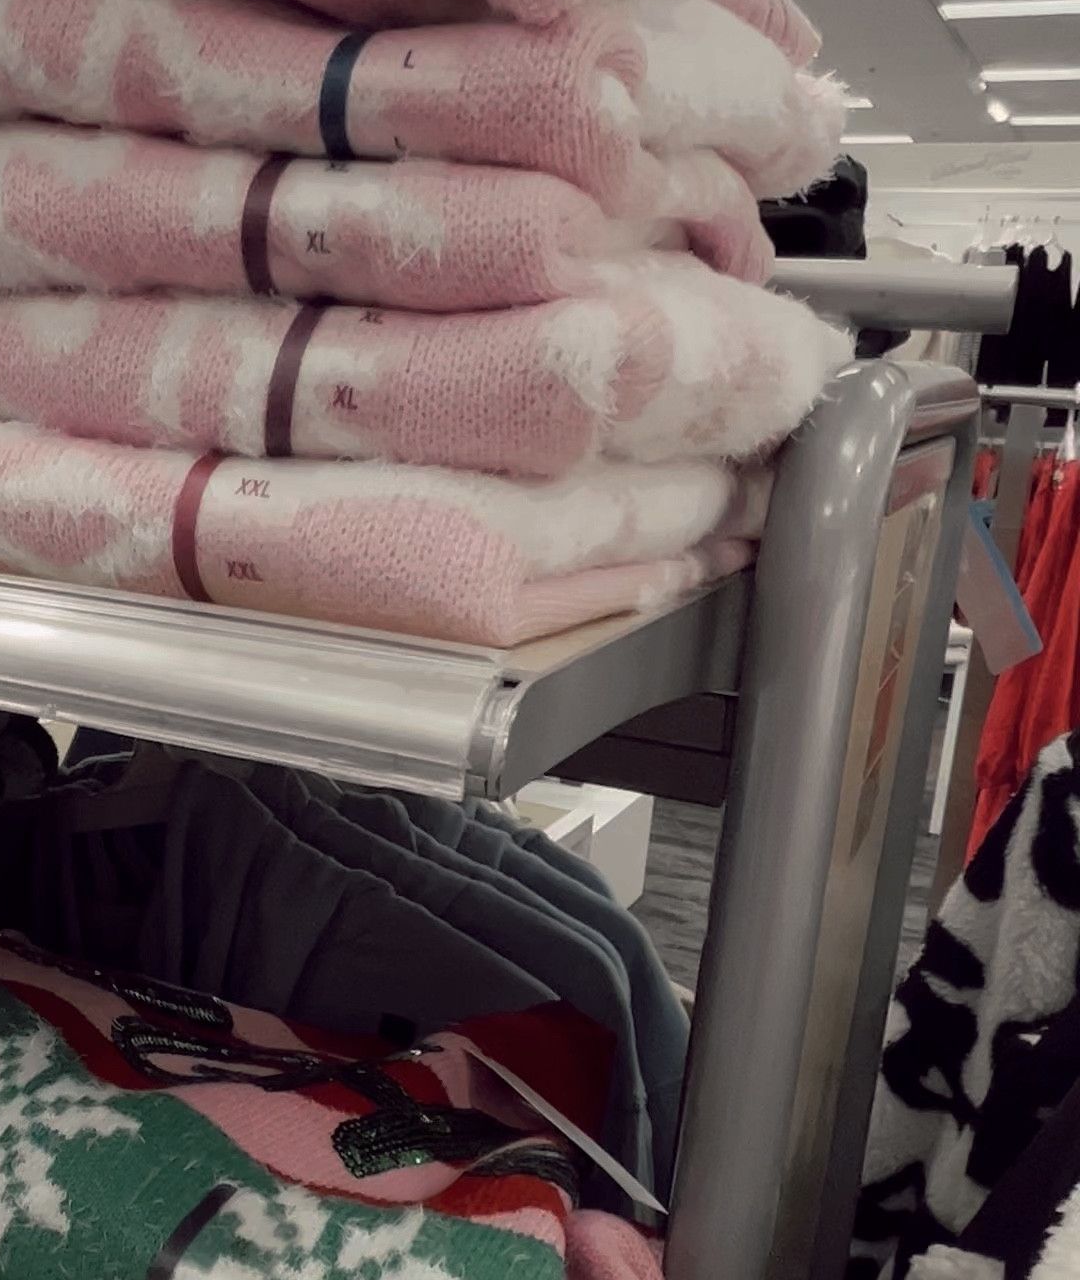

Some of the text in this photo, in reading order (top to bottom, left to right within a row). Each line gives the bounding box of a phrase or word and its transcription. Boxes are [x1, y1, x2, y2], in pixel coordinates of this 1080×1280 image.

[403, 49, 415, 70] L
[305, 230, 331, 254] XL
[332, 384, 358, 410] XL
[234, 477, 271, 499] XXL
[226, 560, 264, 582] XXL
